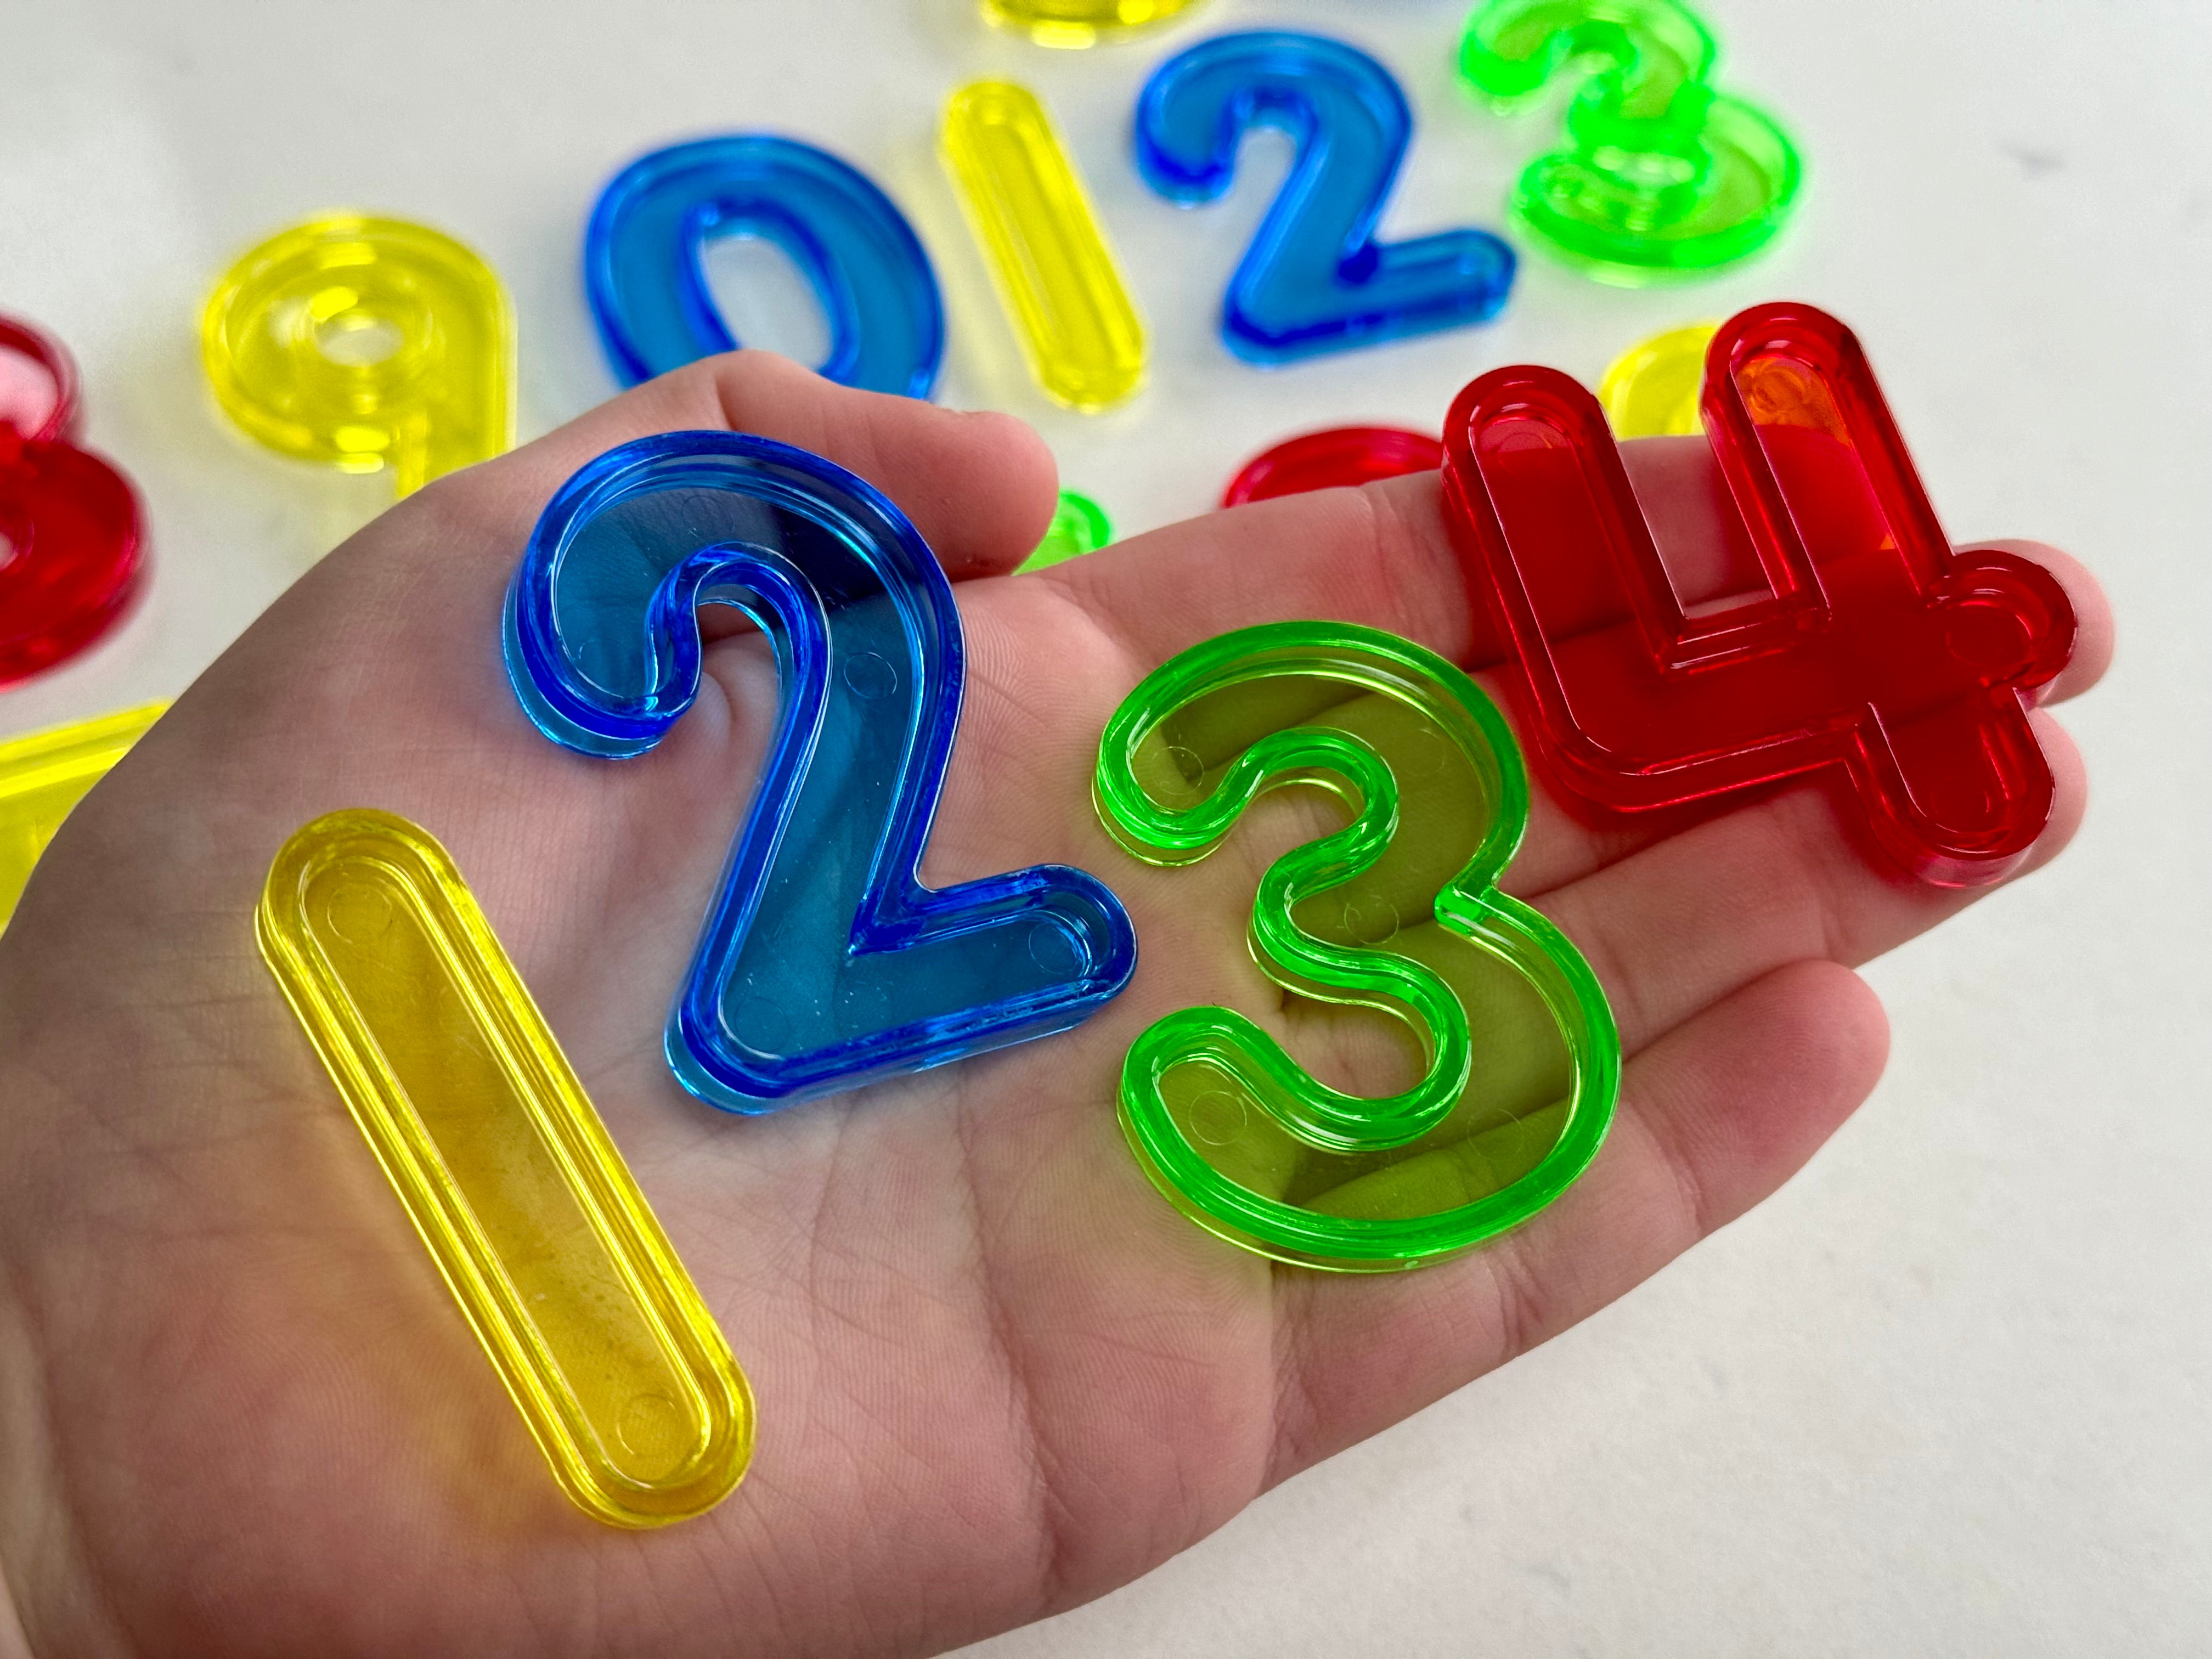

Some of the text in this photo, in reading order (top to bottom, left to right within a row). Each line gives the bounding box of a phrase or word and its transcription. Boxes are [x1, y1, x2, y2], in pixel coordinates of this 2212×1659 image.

[937, 80, 1149, 415] 1
[1133, 31, 1519, 369] 2
[1457, 0, 1802, 288] 3
[501, 430, 1137, 1115] 2
[1441, 301, 2077, 889] 4
[254, 808, 757, 1529] 1
[1091, 620, 1621, 1273] 3
